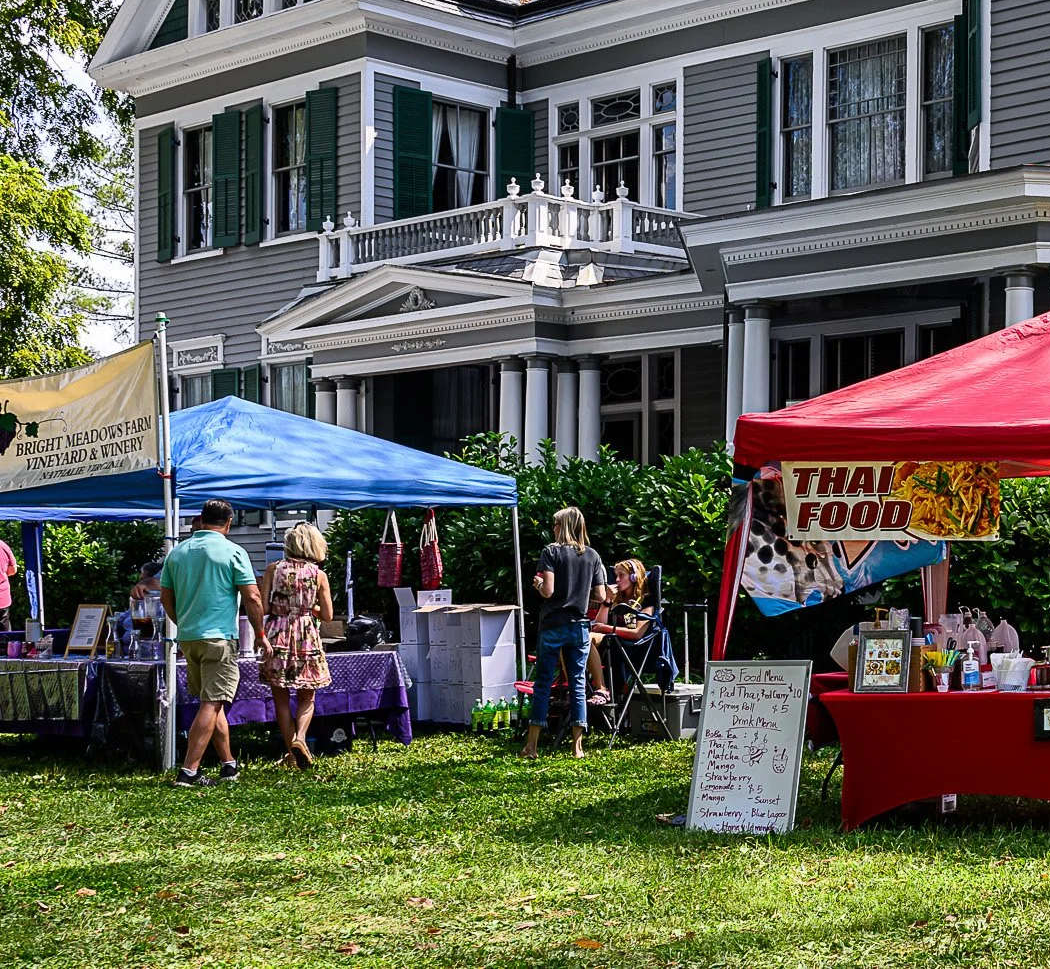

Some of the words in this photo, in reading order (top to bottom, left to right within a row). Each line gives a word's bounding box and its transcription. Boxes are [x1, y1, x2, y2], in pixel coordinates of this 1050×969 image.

[16, 435, 64, 457] BRIGHT
[64, 422, 123, 448] MEADOWS
[125, 415, 152, 436] FARM
[26, 448, 88, 471] VINEYARD
[90, 448, 99, 461] &
[100, 436, 145, 458] WINERY
[792, 465, 895, 497] THAI
[796, 500, 913, 532] FOOD
[739, 668, 762, 682] Food
[764, 670, 784, 682] Menu
[720, 686, 735, 698] Pad
[718, 701, 739, 712] Spring
[741, 701, 755, 711] Roll
[732, 714, 755, 726] Drink
[756, 715, 778, 728] Menu
[708, 749, 740, 760] Matcha
[707, 760, 735, 773] Mango
[705, 771, 752, 784] Strawberry
[701, 793, 725, 805] Mango
[755, 795, 781, 805] Sunset
[700, 807, 742, 822] Strawberry
[751, 807, 766, 817] Blue
